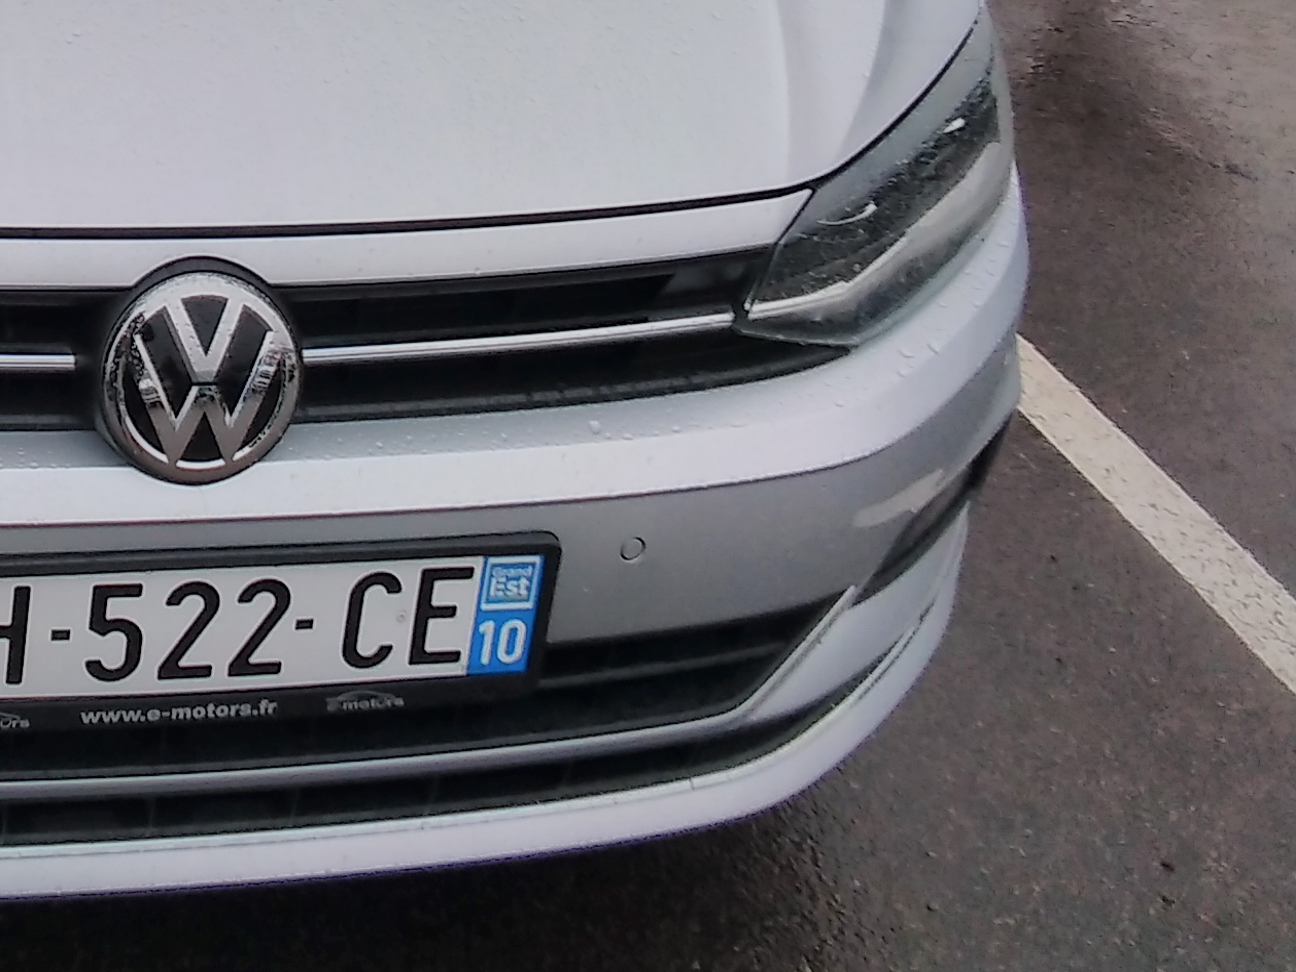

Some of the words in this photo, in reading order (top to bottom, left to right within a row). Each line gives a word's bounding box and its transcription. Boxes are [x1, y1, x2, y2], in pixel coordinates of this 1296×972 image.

[489, 576, 531, 597] Est
[478, 619, 527, 665] 10
[80, 698, 278, 725] www.e-motors.fr
